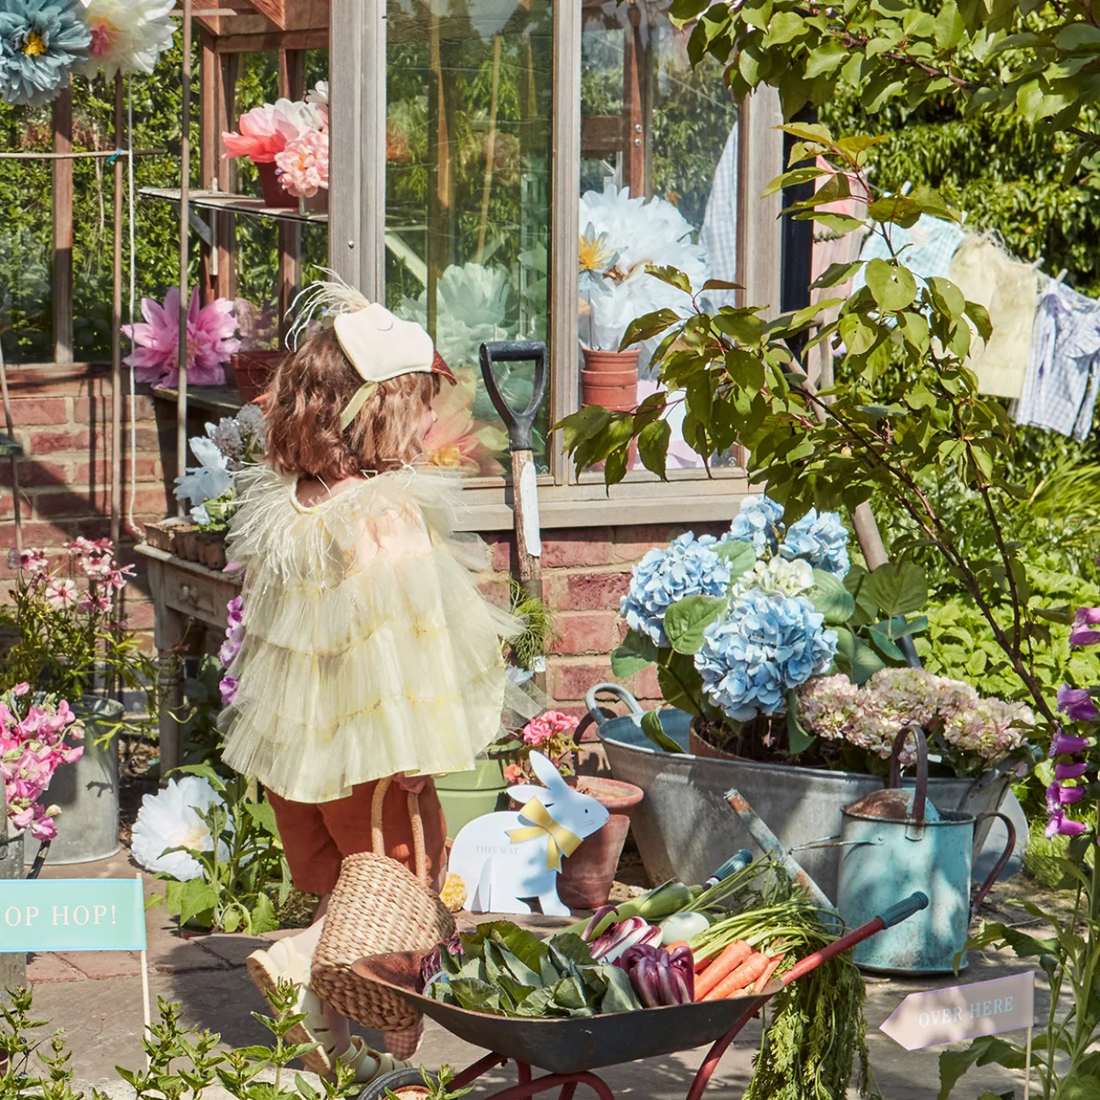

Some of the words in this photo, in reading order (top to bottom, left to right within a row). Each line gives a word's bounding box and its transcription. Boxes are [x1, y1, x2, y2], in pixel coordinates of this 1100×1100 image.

[476, 846, 498, 854] THIS
[500, 847, 519, 855] WAY
[51, 905, 117, 926] HOP!
[918, 1006, 963, 1028] OVER
[970, 996, 1014, 1019] HERE
